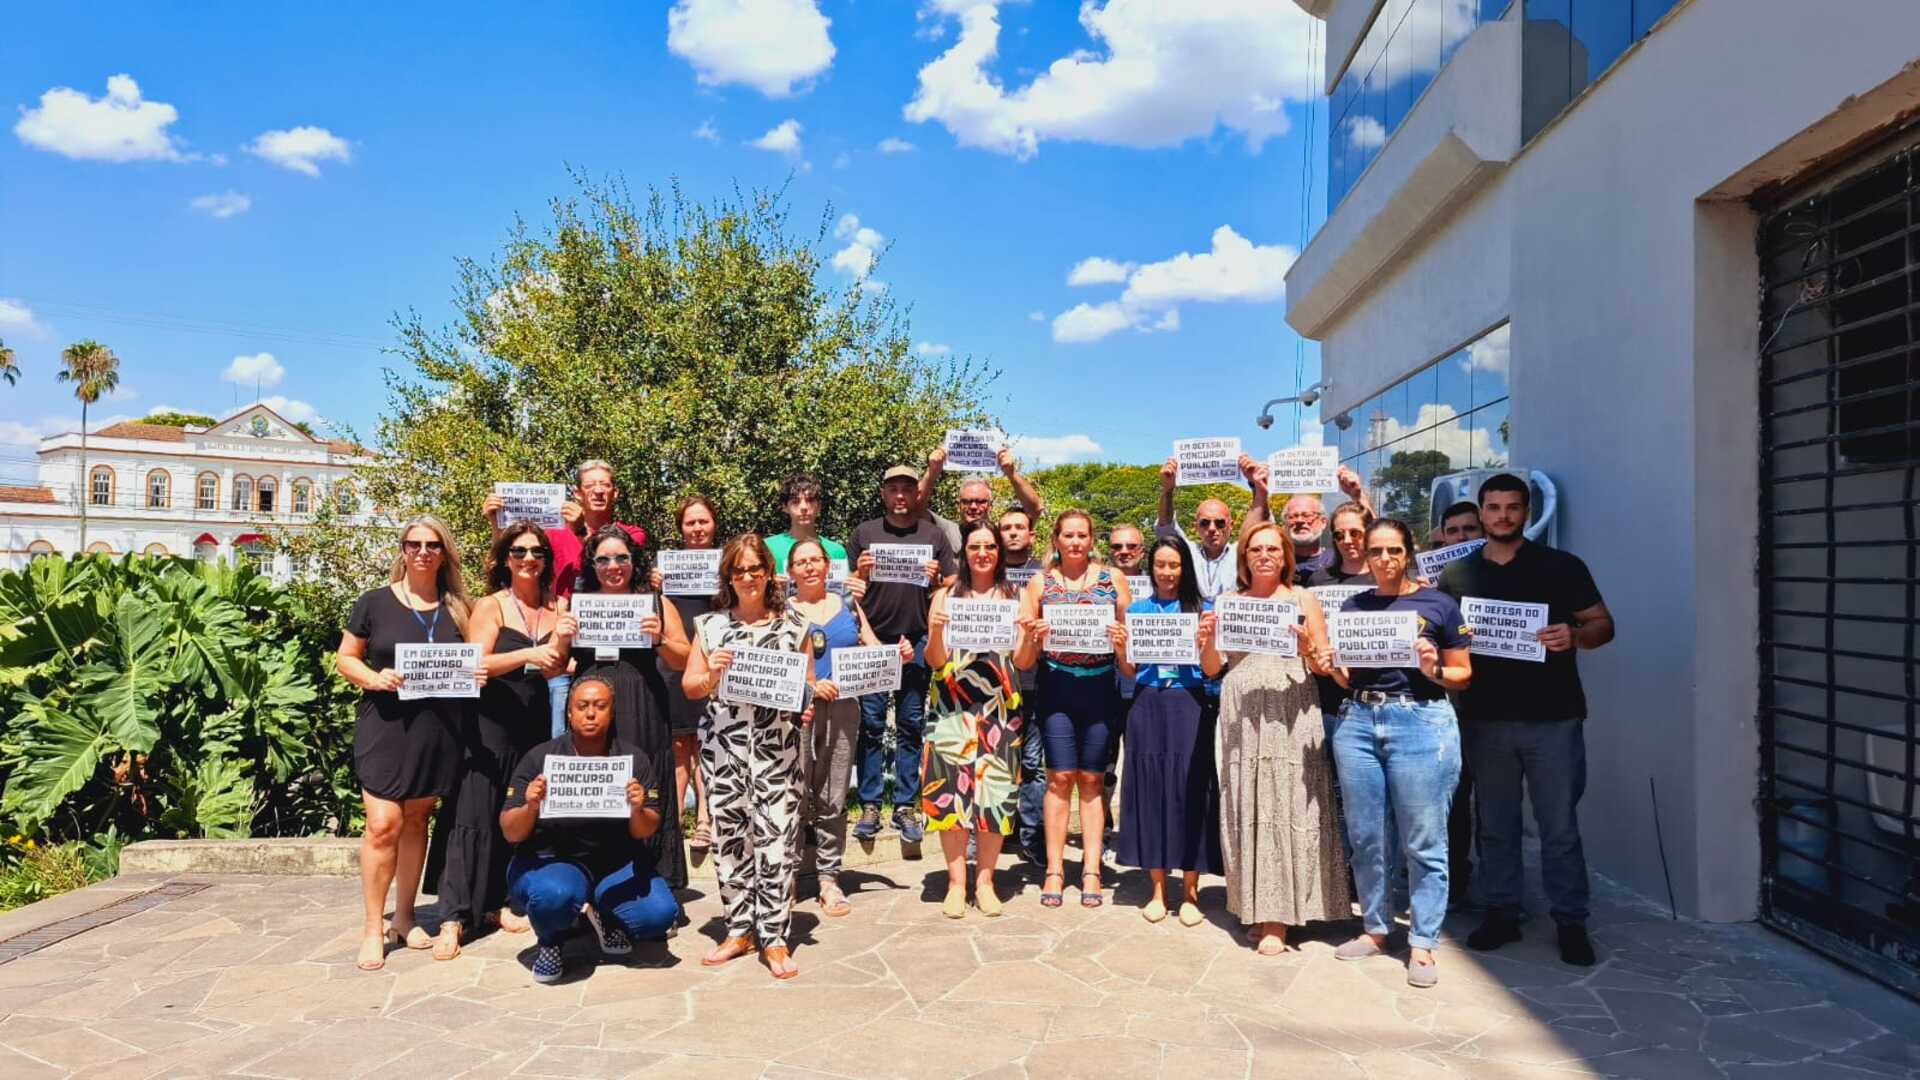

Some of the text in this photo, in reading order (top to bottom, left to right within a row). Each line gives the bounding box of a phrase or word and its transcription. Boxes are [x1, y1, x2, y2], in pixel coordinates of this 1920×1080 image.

[1239, 602, 1274, 612] DEFESA
[1277, 605, 1290, 613] DO
[1468, 603, 1539, 618] EM DEFESA DO
[1223, 612, 1279, 624] CONCURSO
[1337, 616, 1408, 626] EM DEFESA DO
[1468, 614, 1527, 629] CONCURSO
[1132, 628, 1182, 636] CONCURSO
[1337, 627, 1397, 638] CONCURSO
[1471, 627, 1517, 639] UBLICO!
[1500, 641, 1514, 650] de
[420, 648, 457, 658] DEFESA
[1375, 652, 1387, 660] de
[403, 659, 462, 670] CONCURSO
[747, 652, 784, 665] DEFESA
[786, 658, 799, 667] DO
[729, 663, 788, 677] CONCURSO
[760, 692, 773, 700] de
[551, 761, 625, 771] EM DEFESA DO
[551, 773, 614, 783] CONCURSO
[586, 800, 600, 809] de
